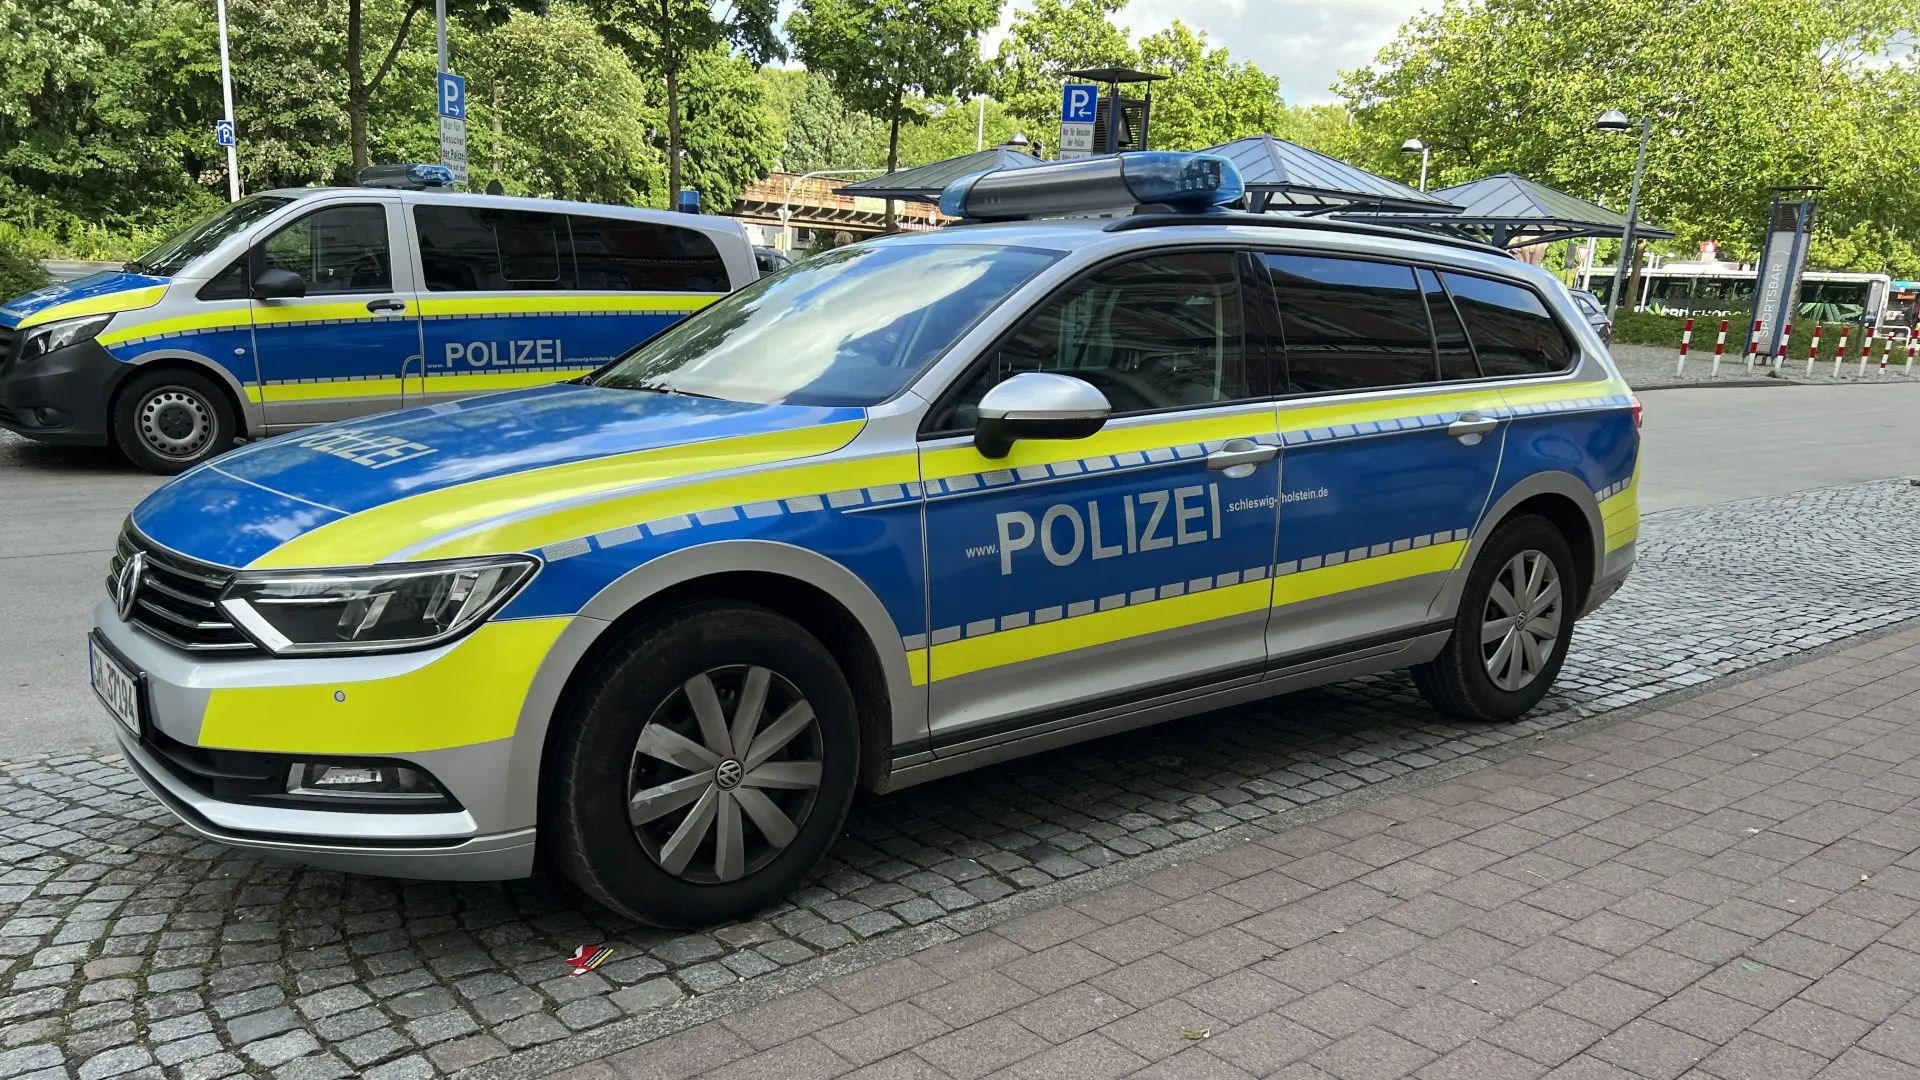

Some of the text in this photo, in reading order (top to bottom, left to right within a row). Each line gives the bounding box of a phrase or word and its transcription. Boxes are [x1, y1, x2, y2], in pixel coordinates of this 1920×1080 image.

[443, 79, 459, 114] P
[1069, 89, 1089, 118] P
[1759, 263, 1784, 338] SPORTSBAR
[445, 339, 562, 368] POLIZEI
[965, 544, 999, 559] www.
[996, 482, 1222, 576] POLIZEI
